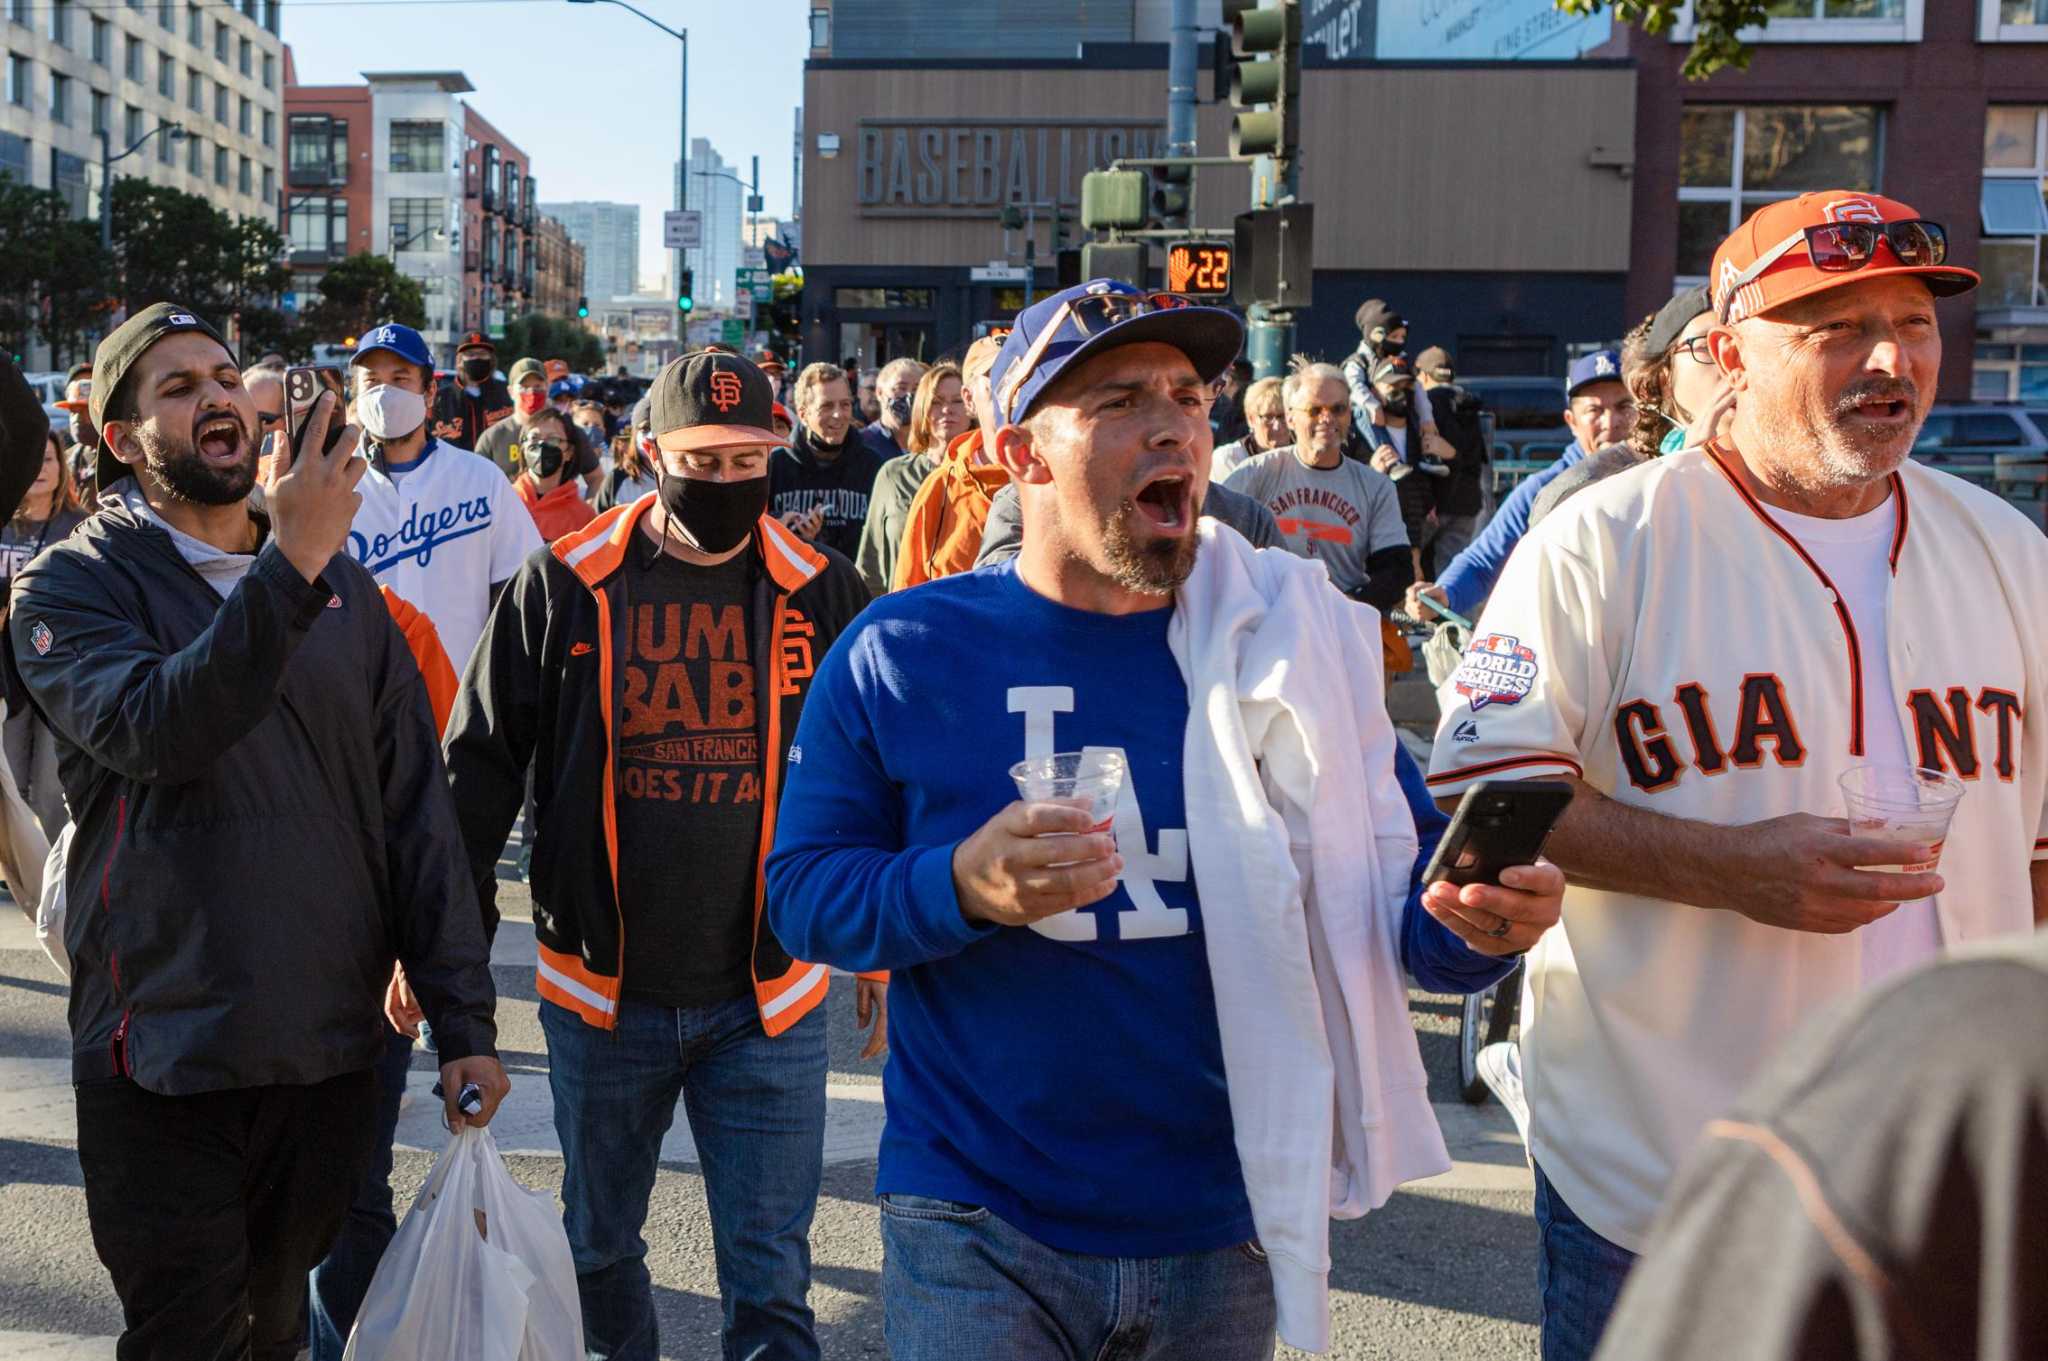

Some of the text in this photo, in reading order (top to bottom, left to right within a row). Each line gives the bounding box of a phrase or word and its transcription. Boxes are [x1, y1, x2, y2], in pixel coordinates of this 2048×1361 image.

[1197, 250, 1230, 290] 22
[376, 327, 397, 344] LA
[1595, 354, 1616, 376] LA
[710, 371, 743, 413] SF
[1270, 487, 1361, 527] SAN FRANCISCO
[347, 496, 491, 568] Dodgers
[1458, 666, 1534, 696] SERIES
[1463, 650, 1538, 680] WORLD
[654, 742, 690, 761] SAN
[618, 766, 682, 801] OES
[692, 772, 729, 802] IT
[1007, 685, 1190, 942] LA
